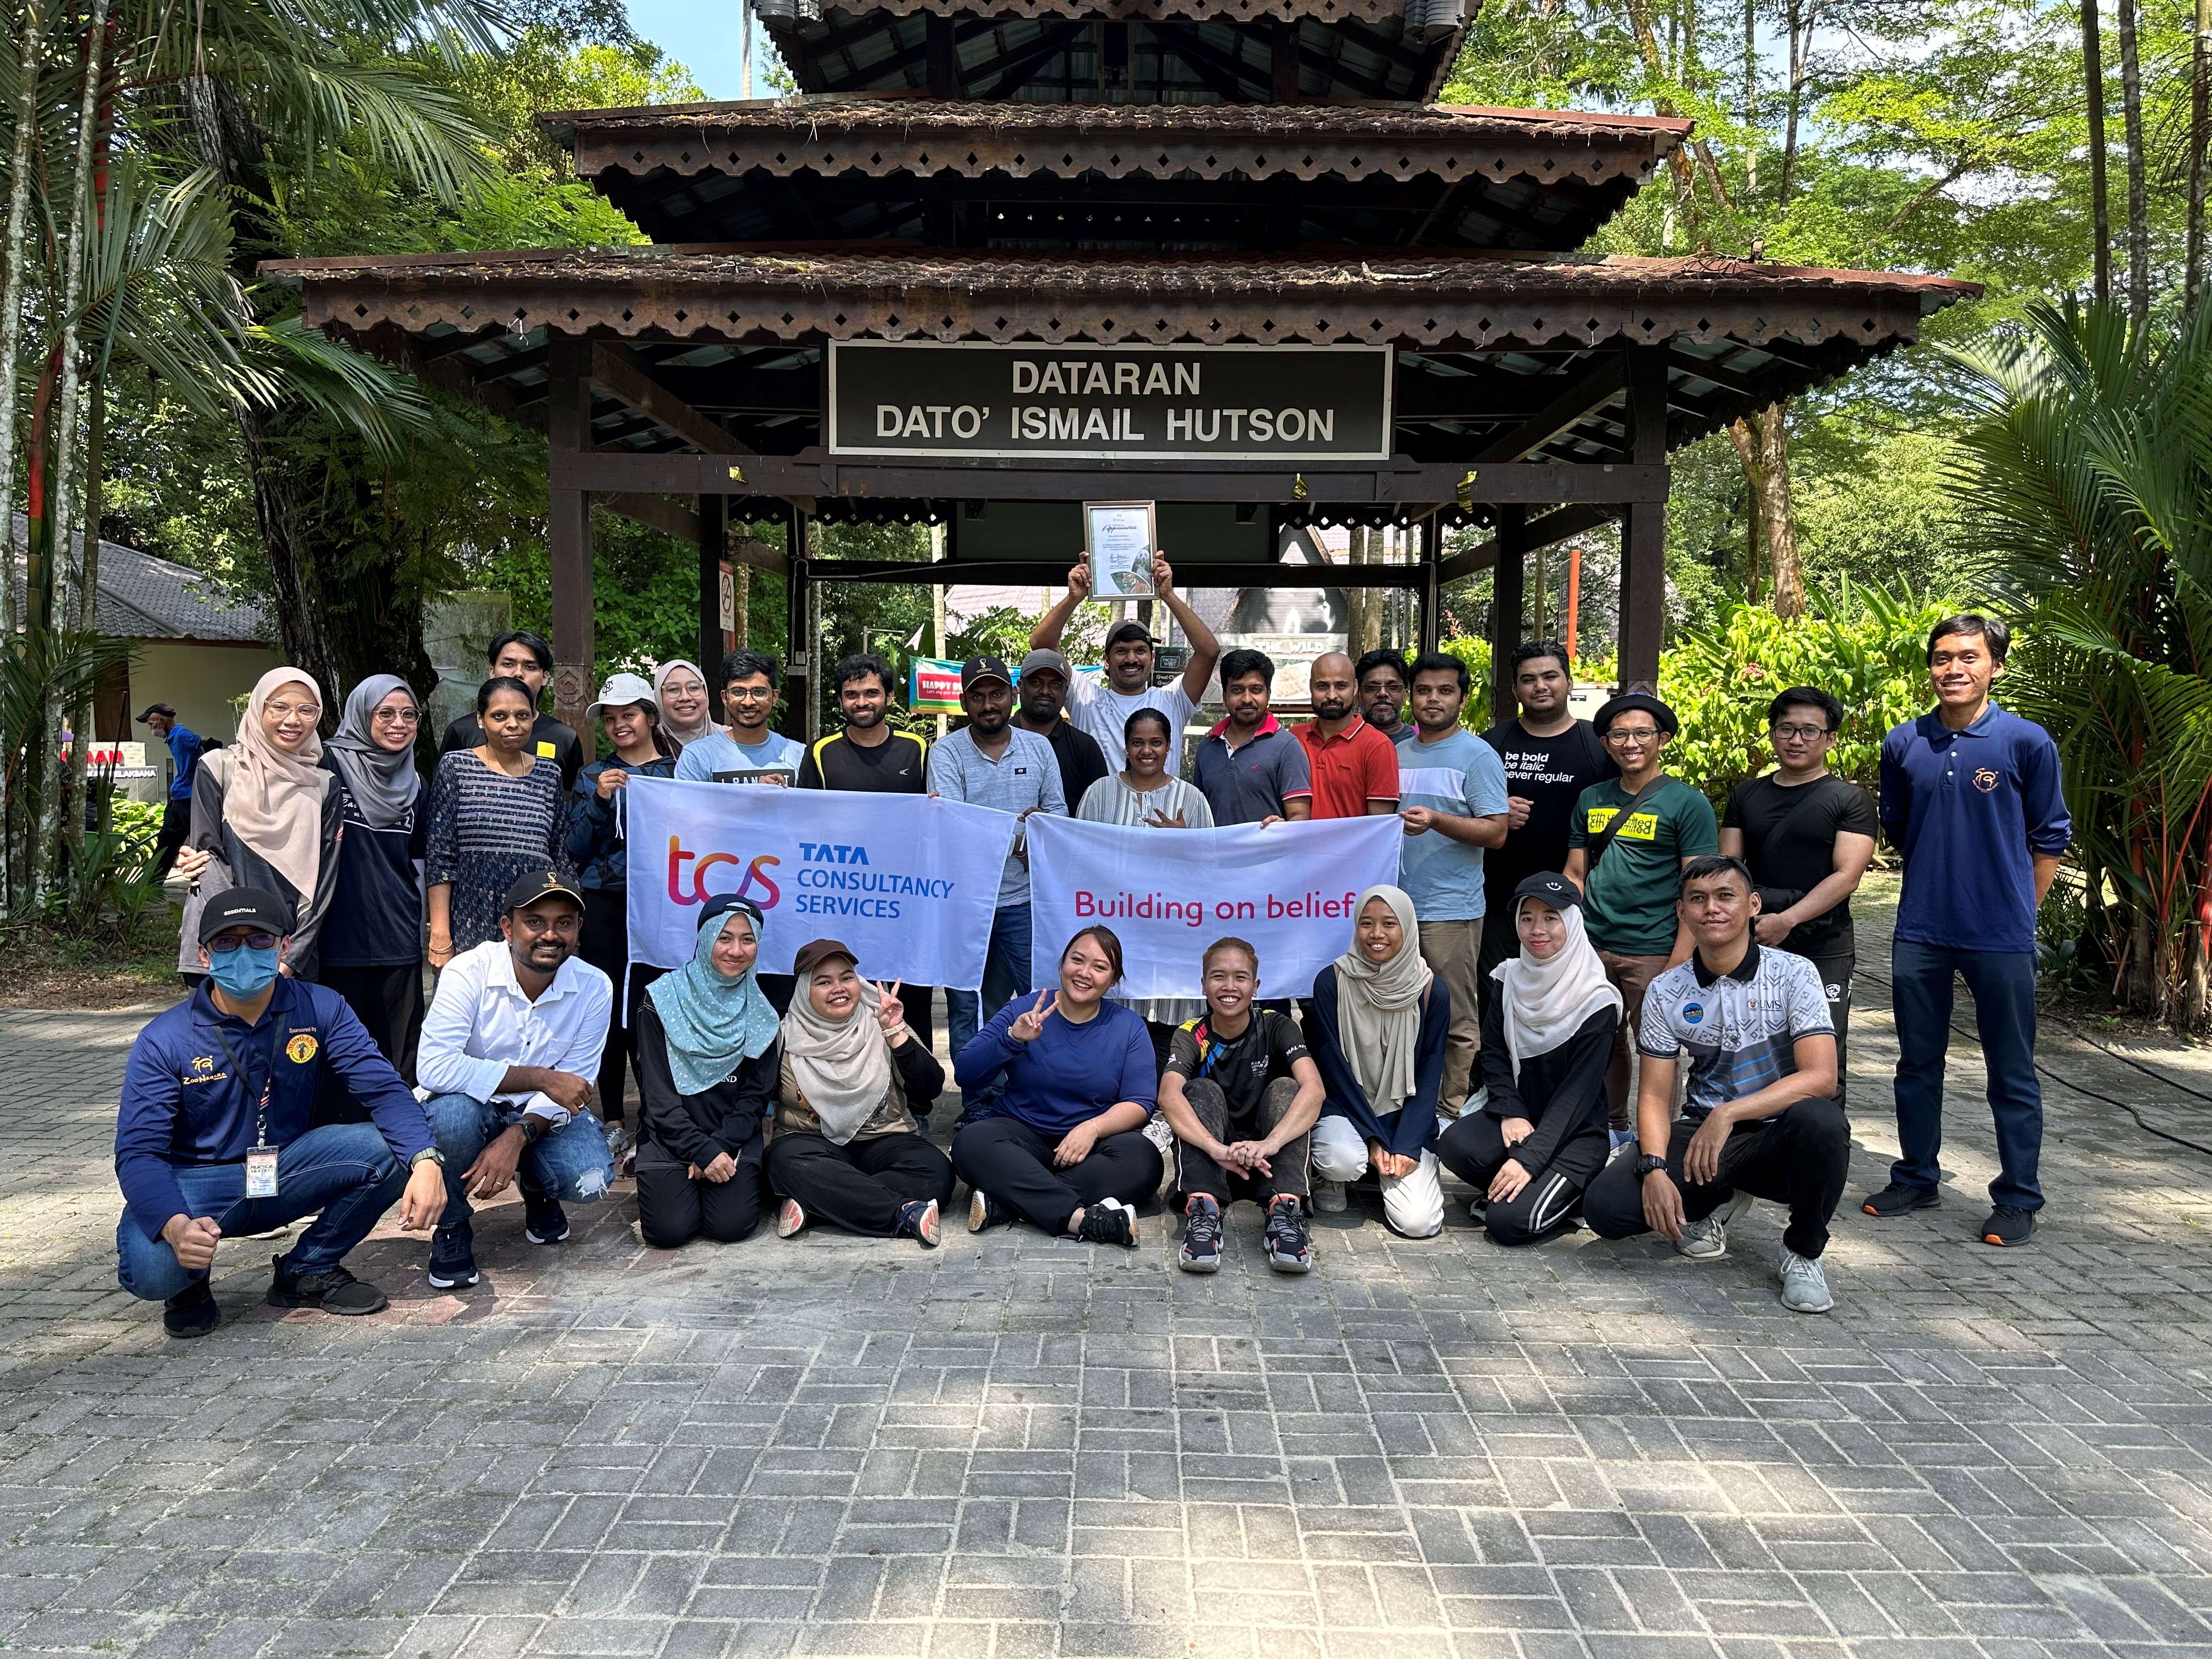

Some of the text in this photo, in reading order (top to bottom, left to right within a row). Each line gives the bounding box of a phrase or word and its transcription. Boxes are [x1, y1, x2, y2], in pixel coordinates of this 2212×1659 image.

[1013, 361, 1200, 395] DATARAN
[877, 405, 1333, 442] DATO' ISMAIL HUTSON
[1255, 641, 1325, 653] THE WILD
[922, 680, 952, 690] HAPPY
[1505, 751, 1550, 763] be bold
[1504, 760, 1545, 771] be italic
[1534, 772, 1575, 784] regular
[668, 835, 870, 911] tcs TATA
[797, 868, 955, 900] CONSULTANCY
[224, 907, 256, 916] ESSENTIALS
[795, 894, 901, 919] SERVICES
[1075, 890, 1356, 928] Building on belief
[1760, 999, 1781, 1009] UMS
